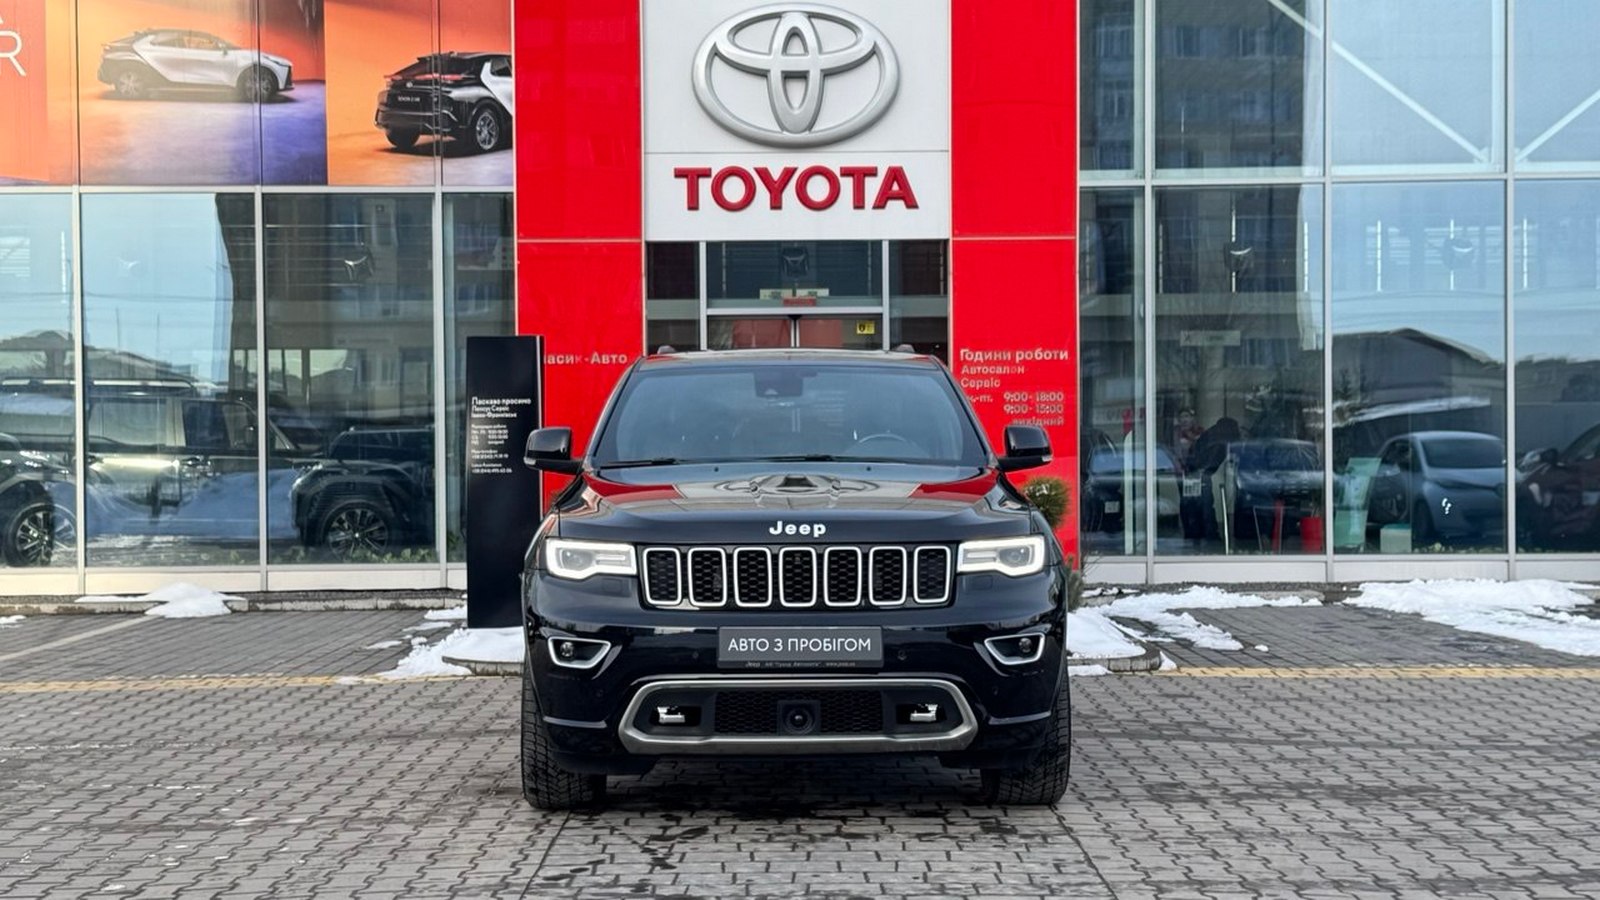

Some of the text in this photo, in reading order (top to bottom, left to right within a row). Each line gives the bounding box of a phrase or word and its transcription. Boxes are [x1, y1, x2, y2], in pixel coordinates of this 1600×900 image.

[673, 165, 919, 212] TOYOTA
[960, 347, 1069, 364] Години роботи
[961, 365, 1025, 375] Автосалон
[960, 377, 1001, 390] Сервіс
[768, 520, 827, 538] Jeep
[728, 637, 770, 652] АВТО
[788, 637, 872, 652] ПРОБІГОМ
